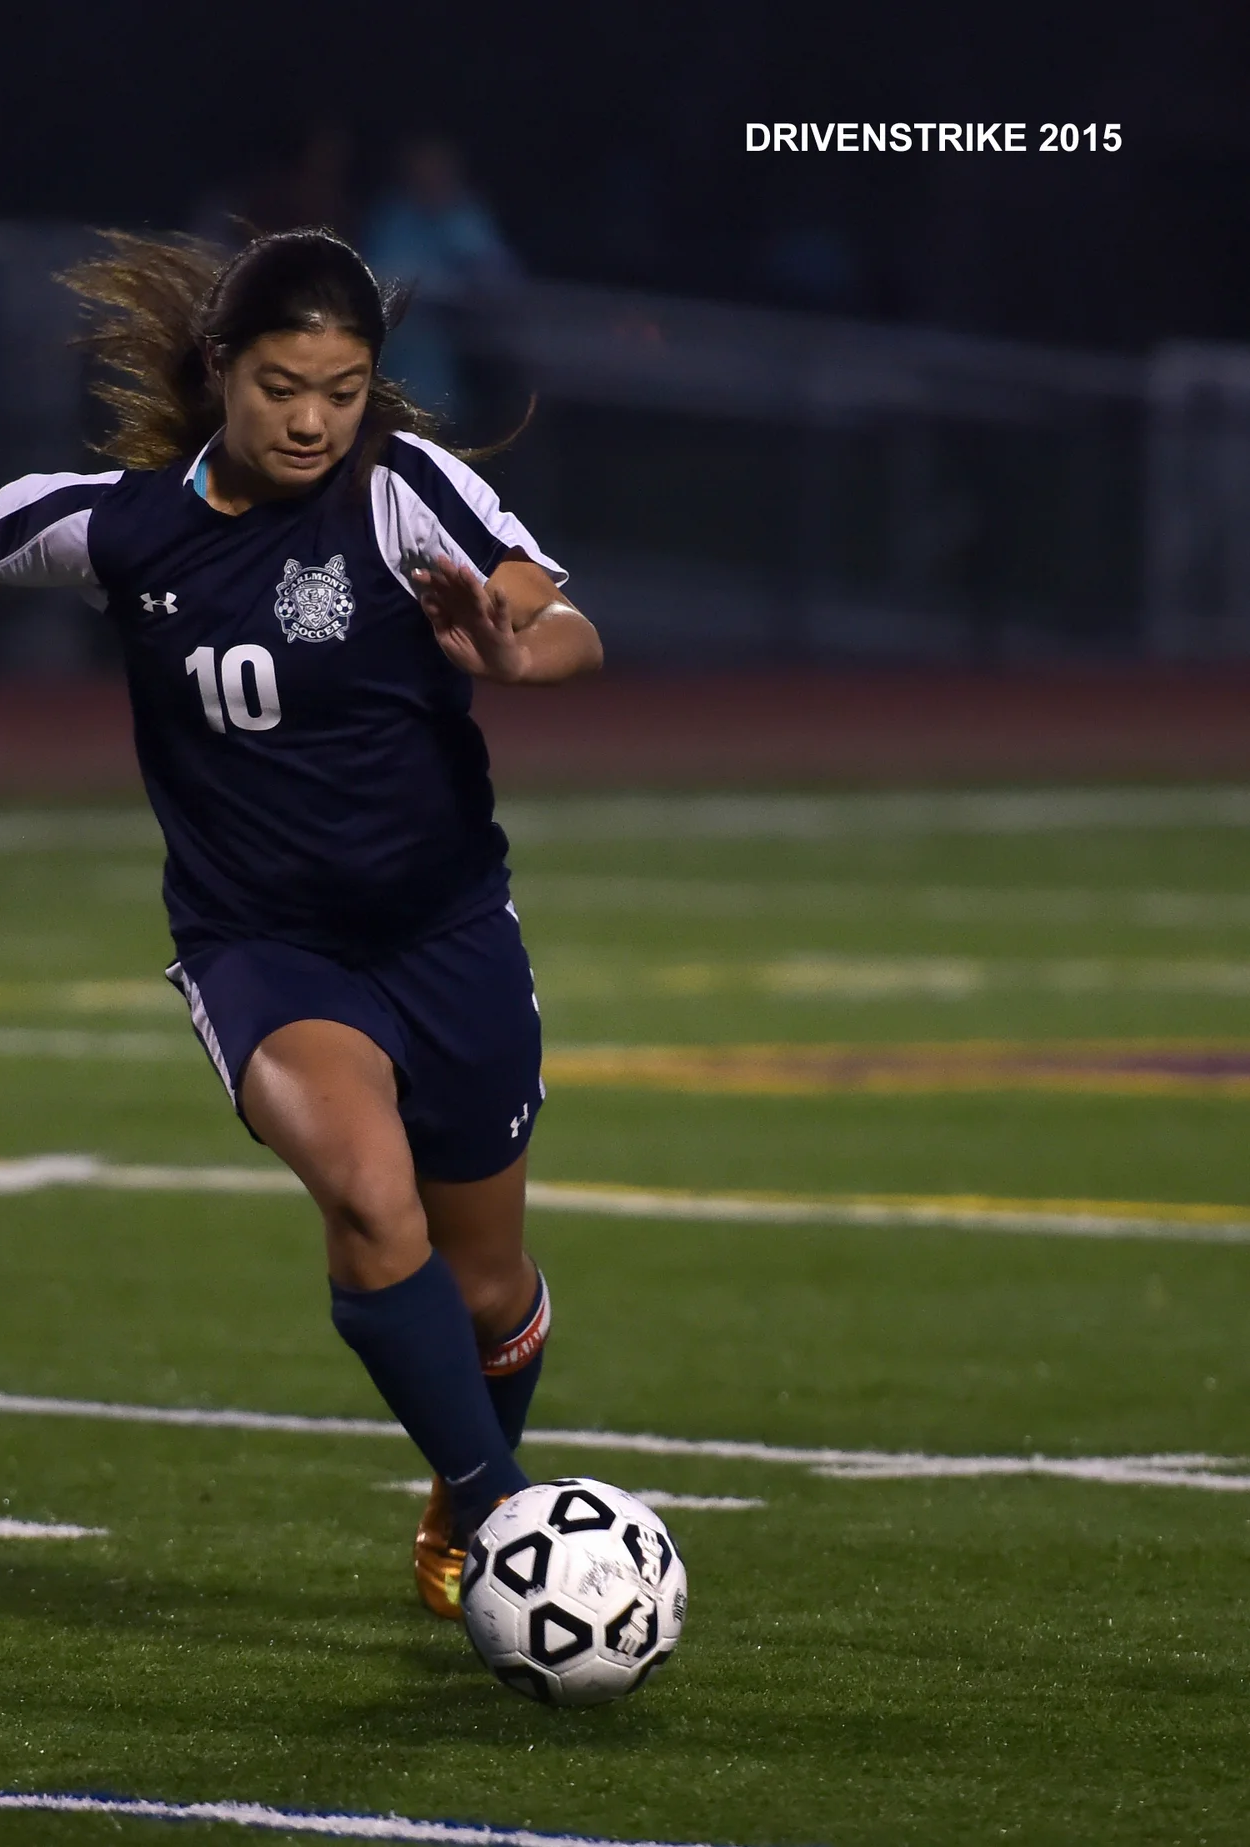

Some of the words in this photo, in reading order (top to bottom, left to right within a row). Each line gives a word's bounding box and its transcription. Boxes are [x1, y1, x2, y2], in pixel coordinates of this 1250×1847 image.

[283, 571, 348, 596] CARLMONT
[290, 619, 342, 639] SOCCER
[185, 643, 282, 734] 10
